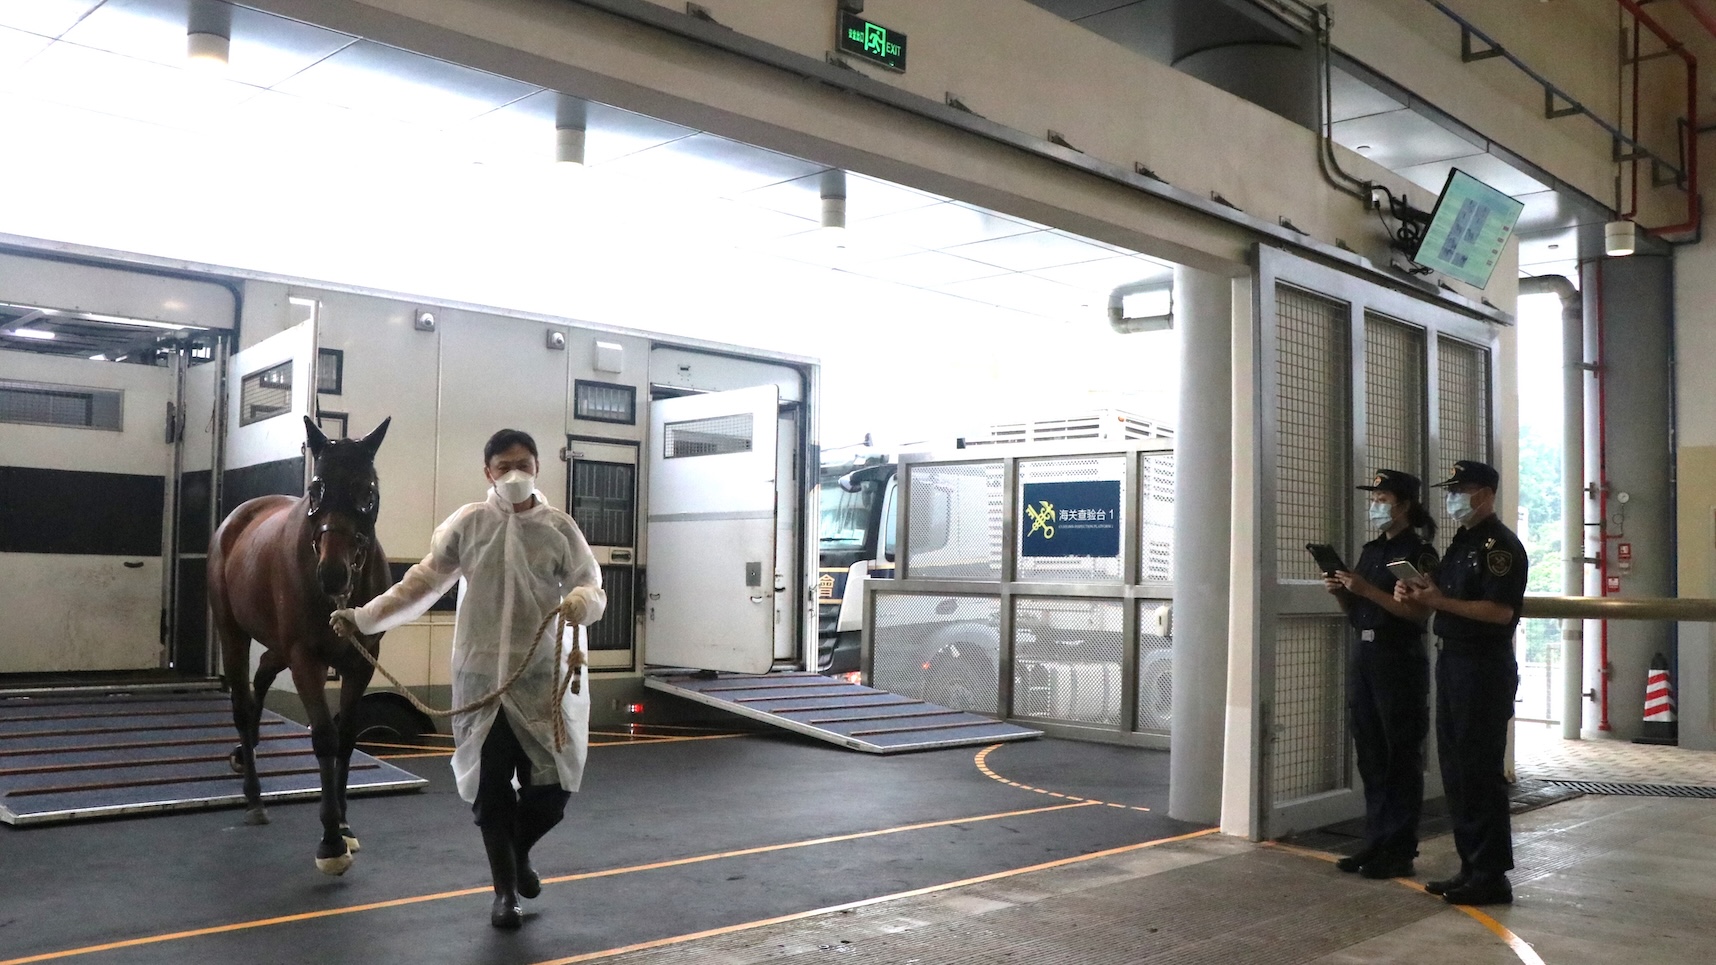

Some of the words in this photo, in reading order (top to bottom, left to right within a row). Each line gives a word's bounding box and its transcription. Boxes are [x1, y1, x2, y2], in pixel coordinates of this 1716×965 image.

[886, 41, 901, 57] EXIT
[1058, 508, 1106, 521] 海关查验台
[1109, 508, 1114, 520] 1
[819, 573, 835, 598] 會
